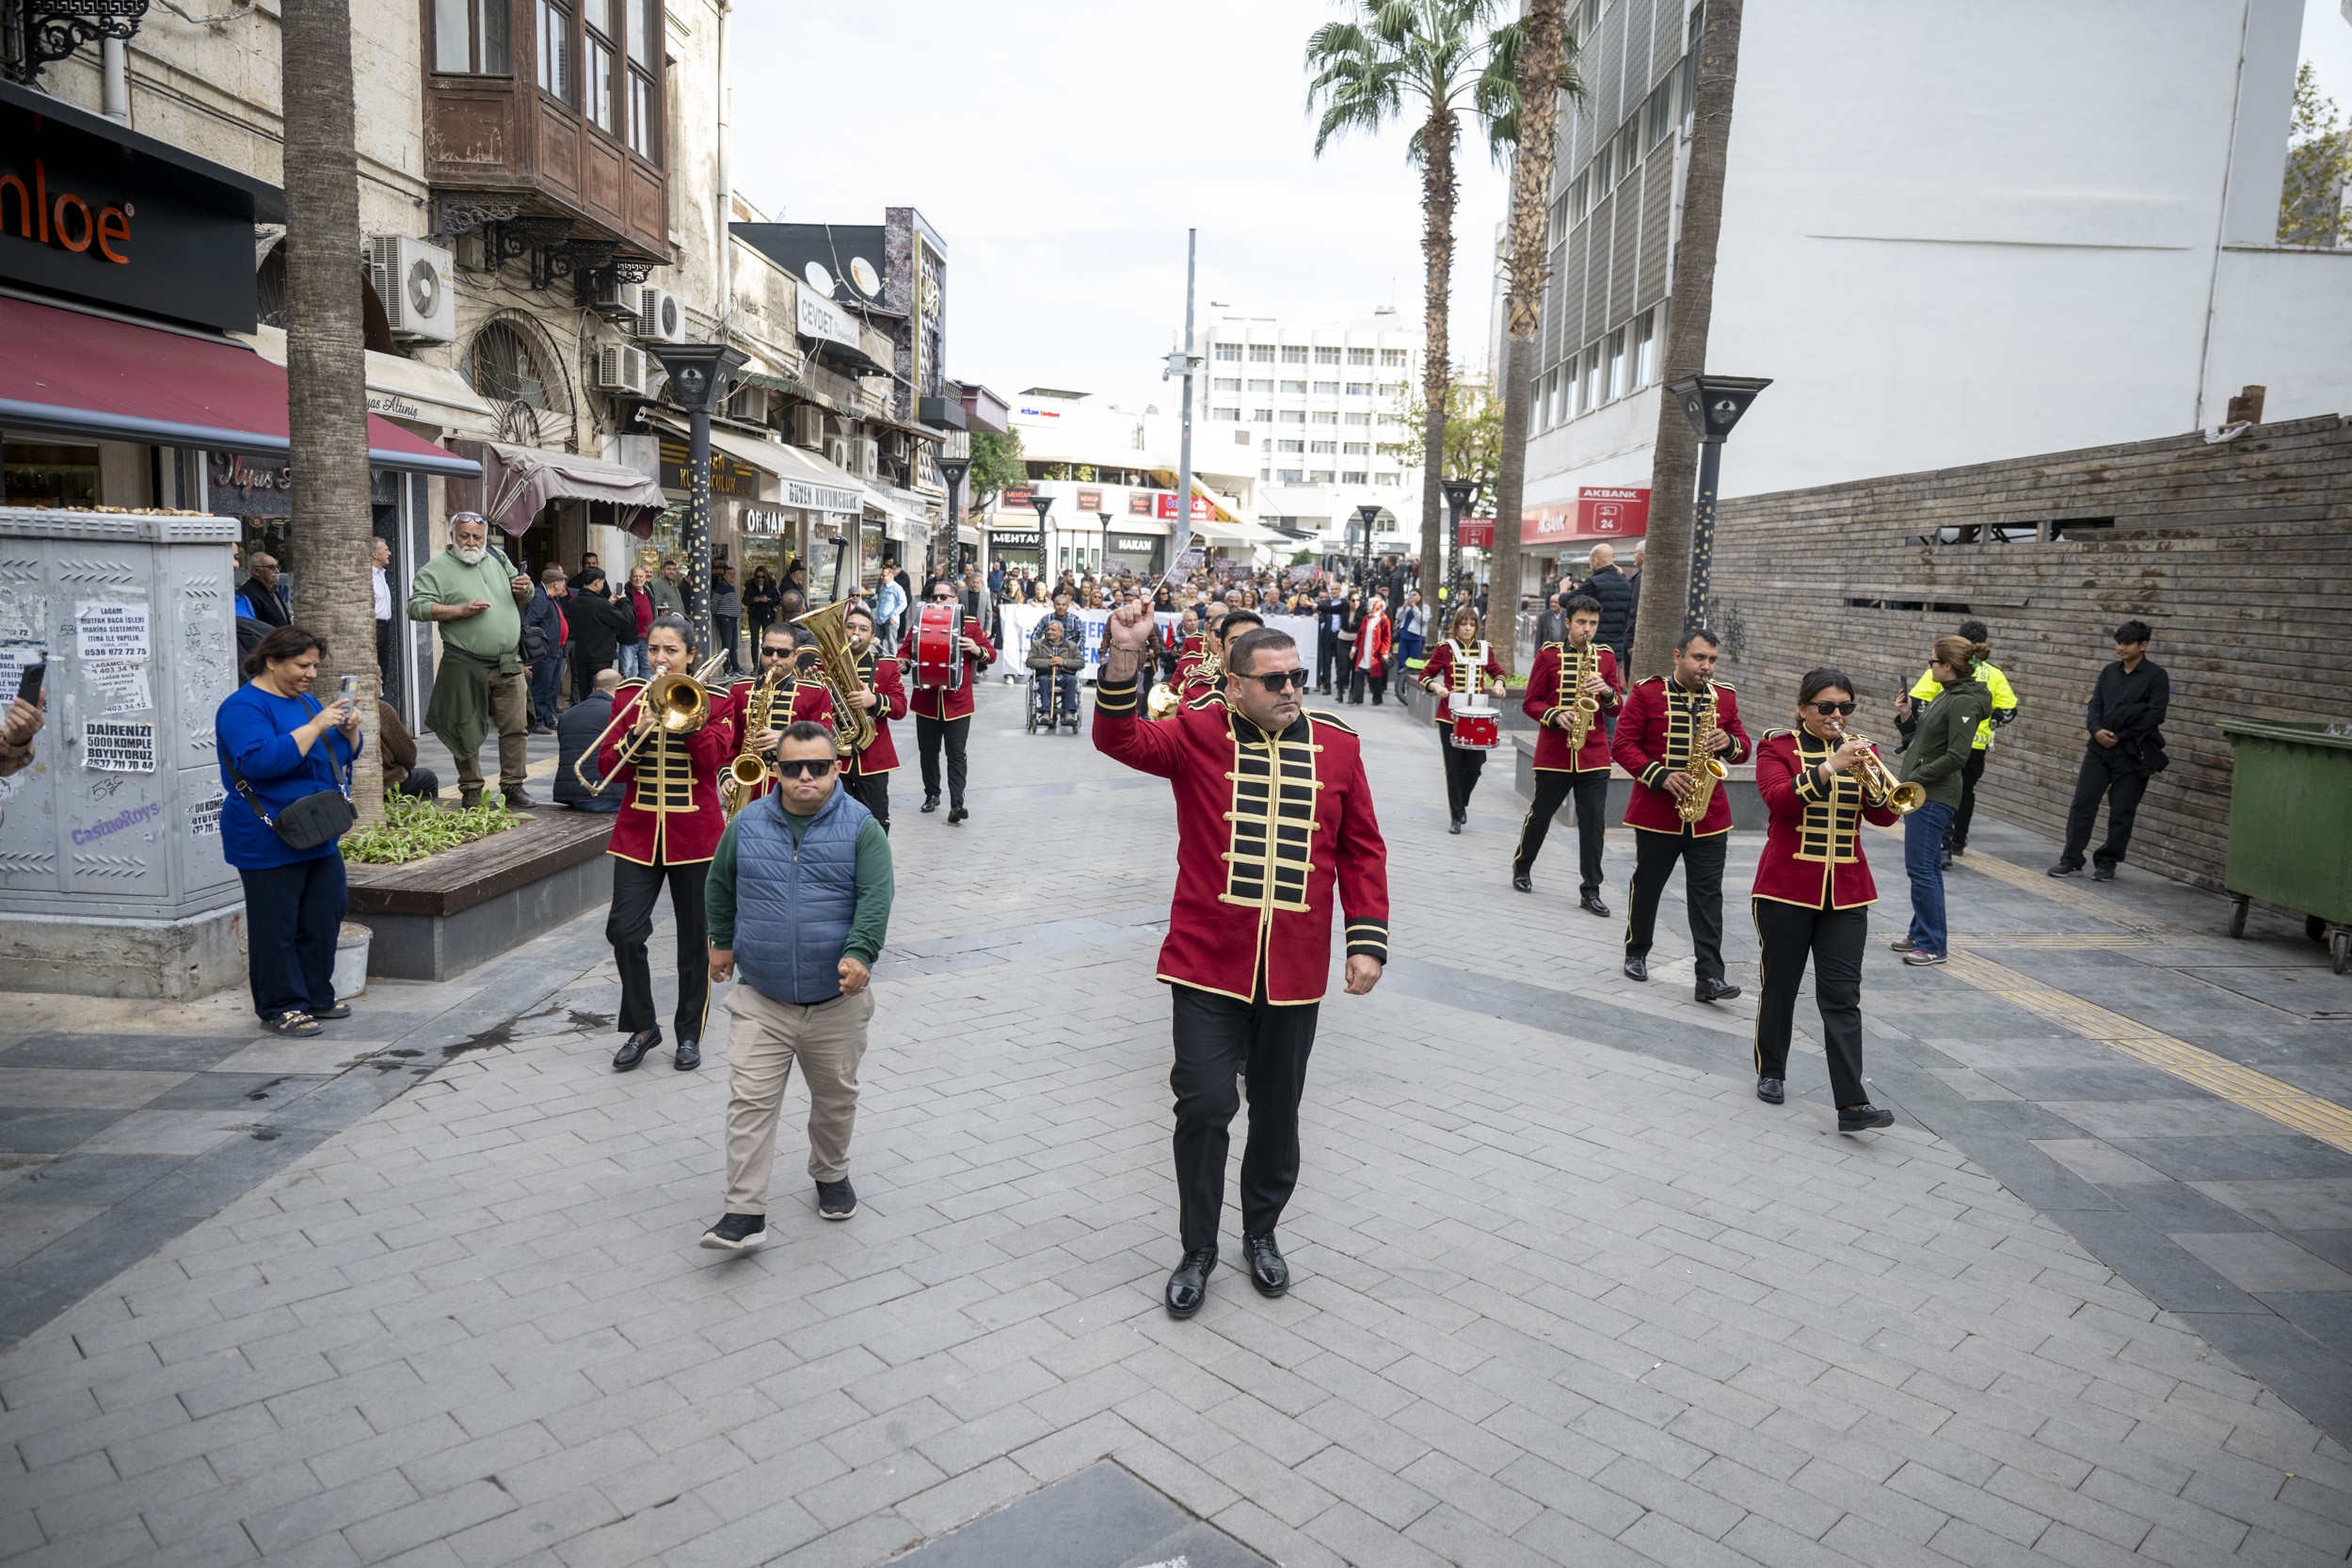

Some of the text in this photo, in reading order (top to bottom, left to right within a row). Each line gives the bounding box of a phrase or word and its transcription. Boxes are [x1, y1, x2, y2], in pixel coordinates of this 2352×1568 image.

[802, 298, 833, 336] CEVDET
[789, 483, 811, 504] GÜVEN
[816, 488, 857, 509] KUYUMCULUK
[1583, 489, 1637, 498] AKBANK
[747, 509, 785, 534] ORHAN
[1601, 520, 1613, 529] 24
[1119, 539, 1152, 551] HAKAN
[125, 616, 145, 625] İŞLERİ
[88, 737, 152, 749] 5000 KOMPLE
[88, 748, 152, 760] BOYUYORUZ
[113, 760, 125, 769] 711
[128, 760, 138, 769] 70
